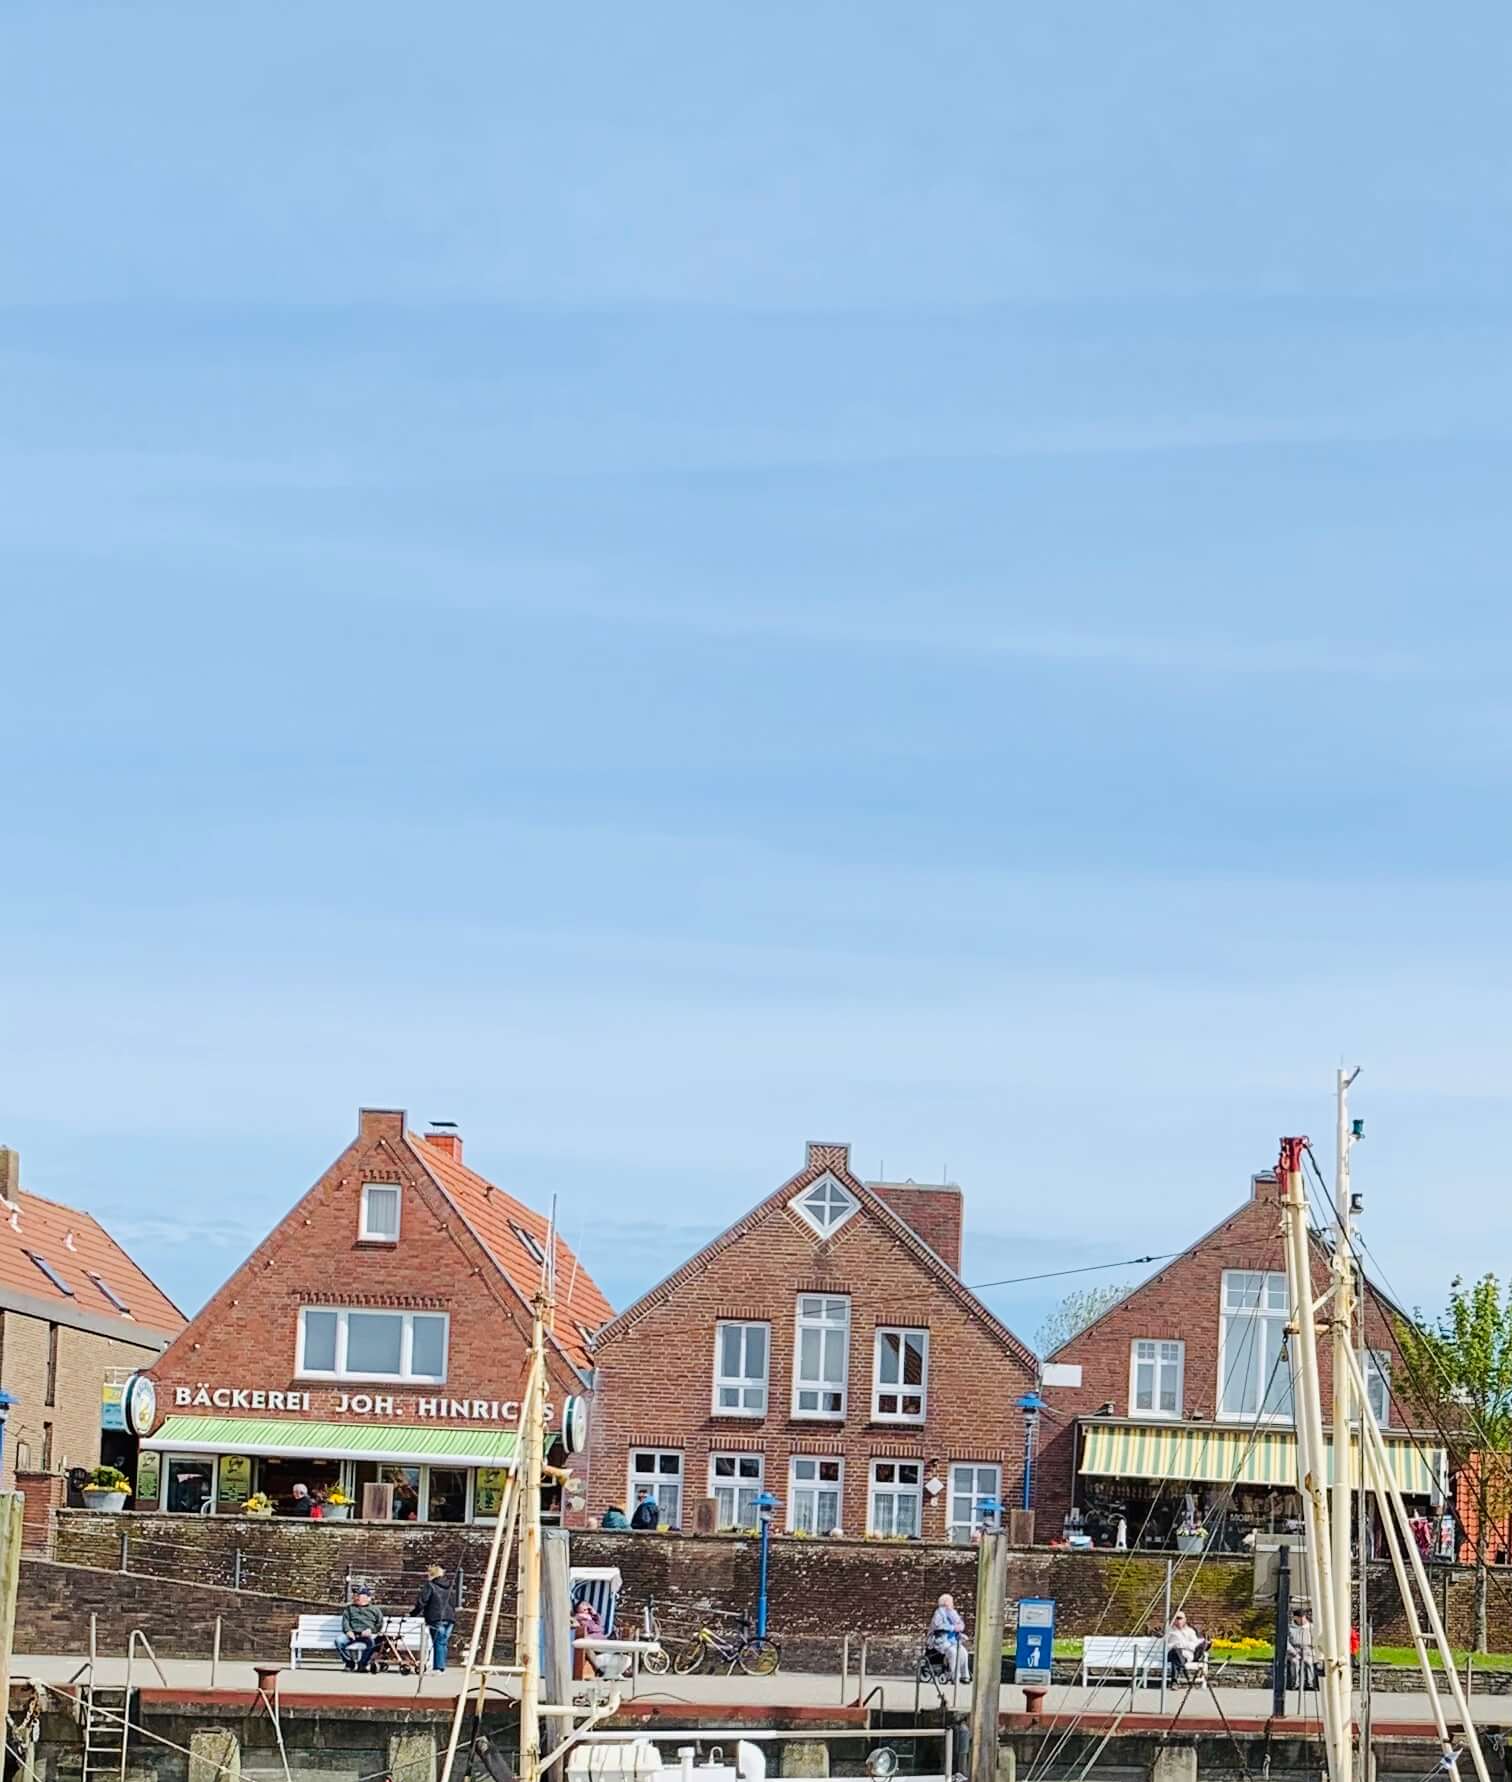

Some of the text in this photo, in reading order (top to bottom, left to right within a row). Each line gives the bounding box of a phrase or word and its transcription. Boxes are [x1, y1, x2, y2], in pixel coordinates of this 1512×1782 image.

[175, 1382, 310, 1412] BÄCKEREI
[335, 1393, 404, 1416] JOH.
[417, 1397, 555, 1422] HINRICS
